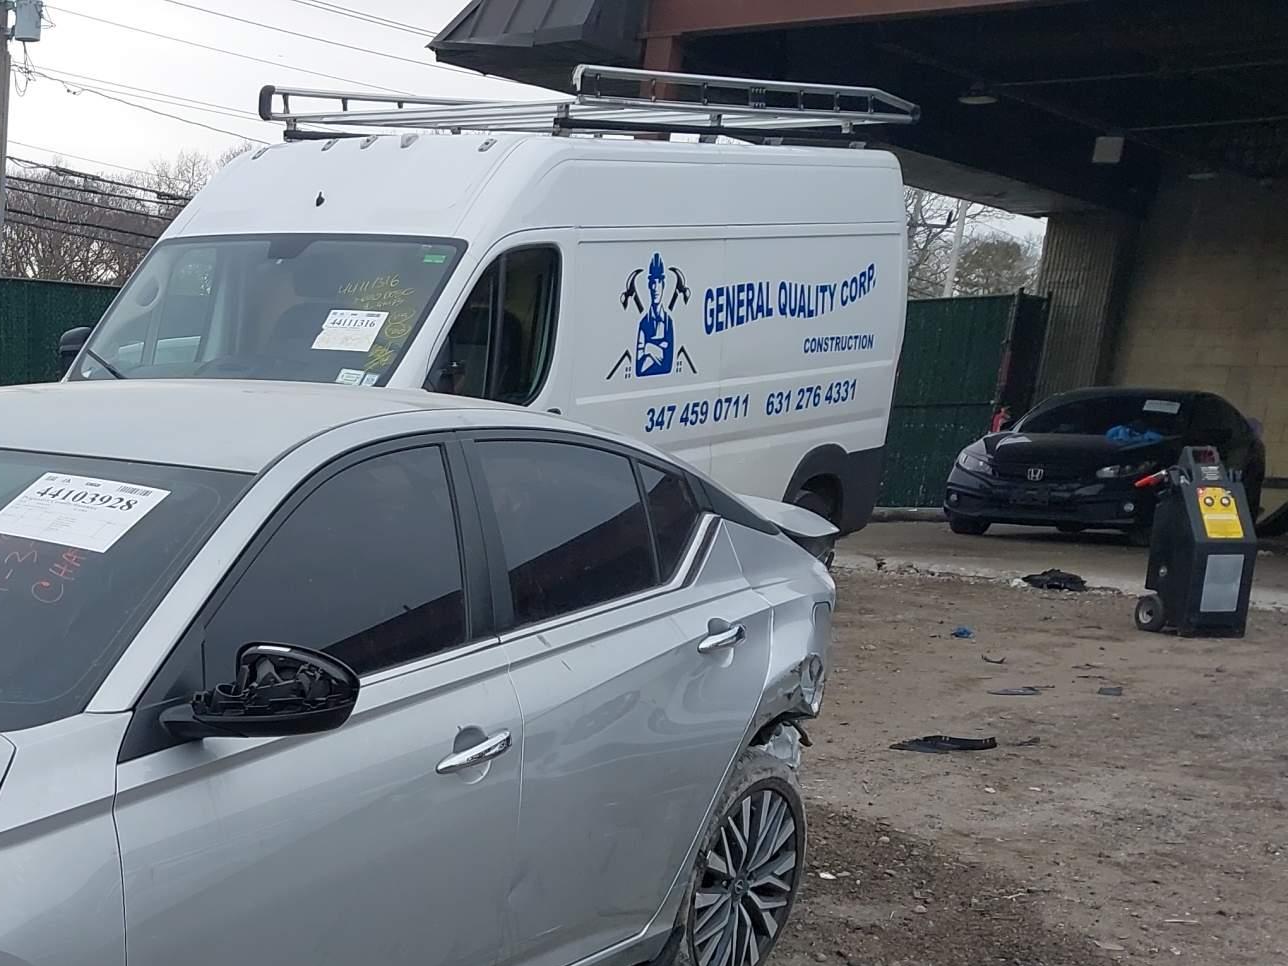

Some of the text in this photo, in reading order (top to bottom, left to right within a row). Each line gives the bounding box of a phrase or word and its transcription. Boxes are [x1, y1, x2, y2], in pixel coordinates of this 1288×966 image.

[703, 263, 876, 335] GENERAL QUALITY CORP.
[803, 334, 874, 354] CONSTRUCTION
[645, 379, 857, 433] 347 459 0711 631 276 4331
[36, 486, 139, 512] 44103928
